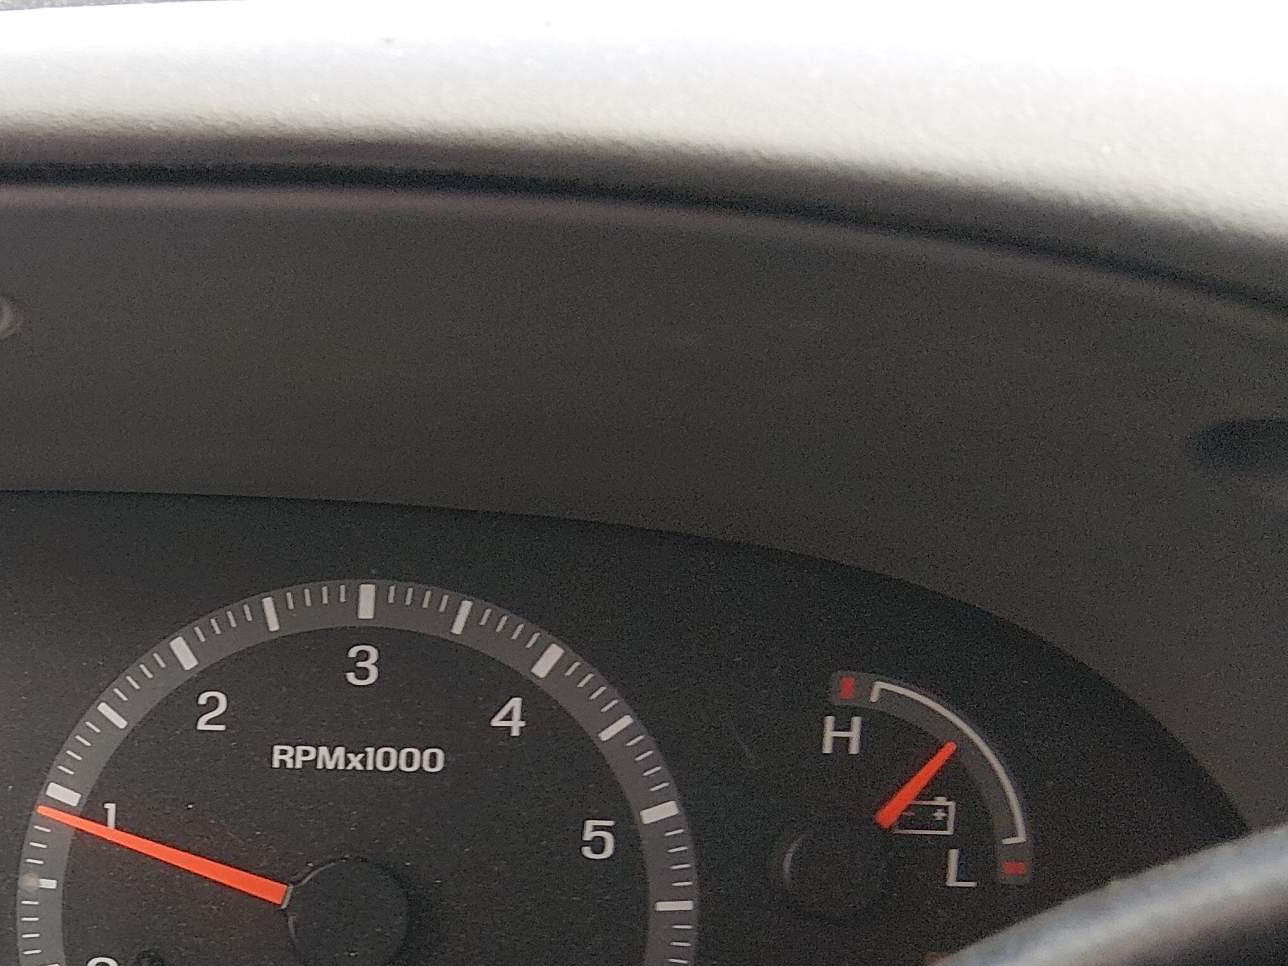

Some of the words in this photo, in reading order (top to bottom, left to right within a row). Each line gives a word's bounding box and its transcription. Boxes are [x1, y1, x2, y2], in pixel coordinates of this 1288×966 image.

[346, 645, 378, 685] 3
[197, 692, 226, 730] 2
[491, 698, 525, 736] 4
[823, 716, 861, 754] H
[272, 745, 444, 772] RPMx1000
[103, 803, 116, 829] 1
[582, 820, 614, 859] 5
[946, 849, 977, 886] L
